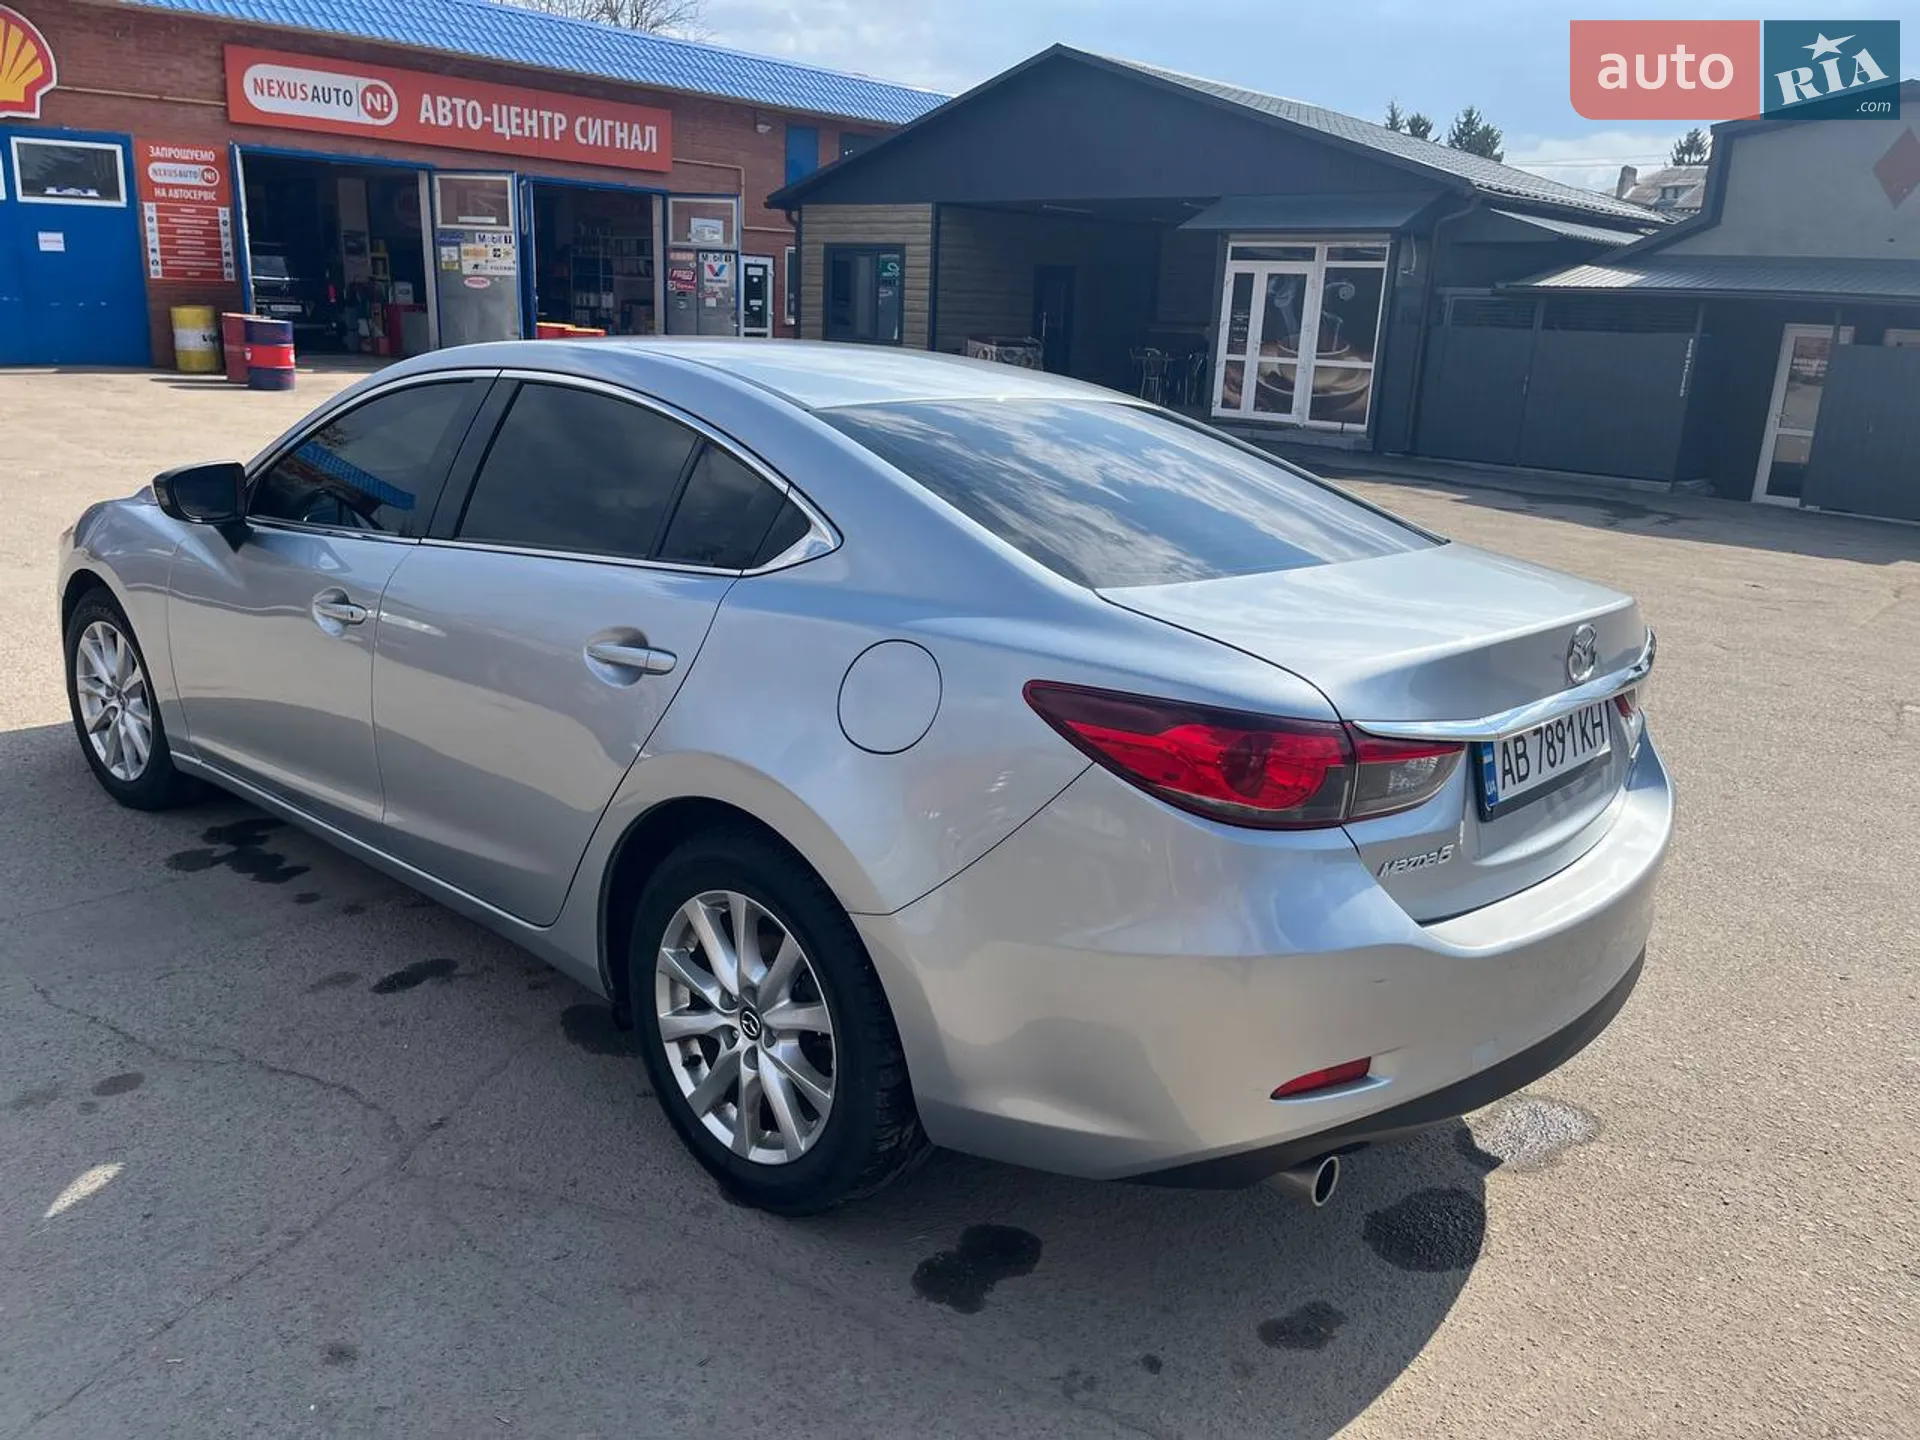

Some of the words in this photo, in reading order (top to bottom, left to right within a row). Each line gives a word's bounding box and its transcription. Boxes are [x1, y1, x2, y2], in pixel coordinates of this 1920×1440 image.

[252, 77, 353, 108] NEXUSAUTO
[418, 93, 567, 141] АВТО-ЦЕНТР
[574, 115, 658, 153] СИГНАЛ
[154, 187, 167, 198] НА
[1502, 734, 1530, 790] AB
[1533, 714, 1577, 774] 7891
[1578, 702, 1605, 754] KH
